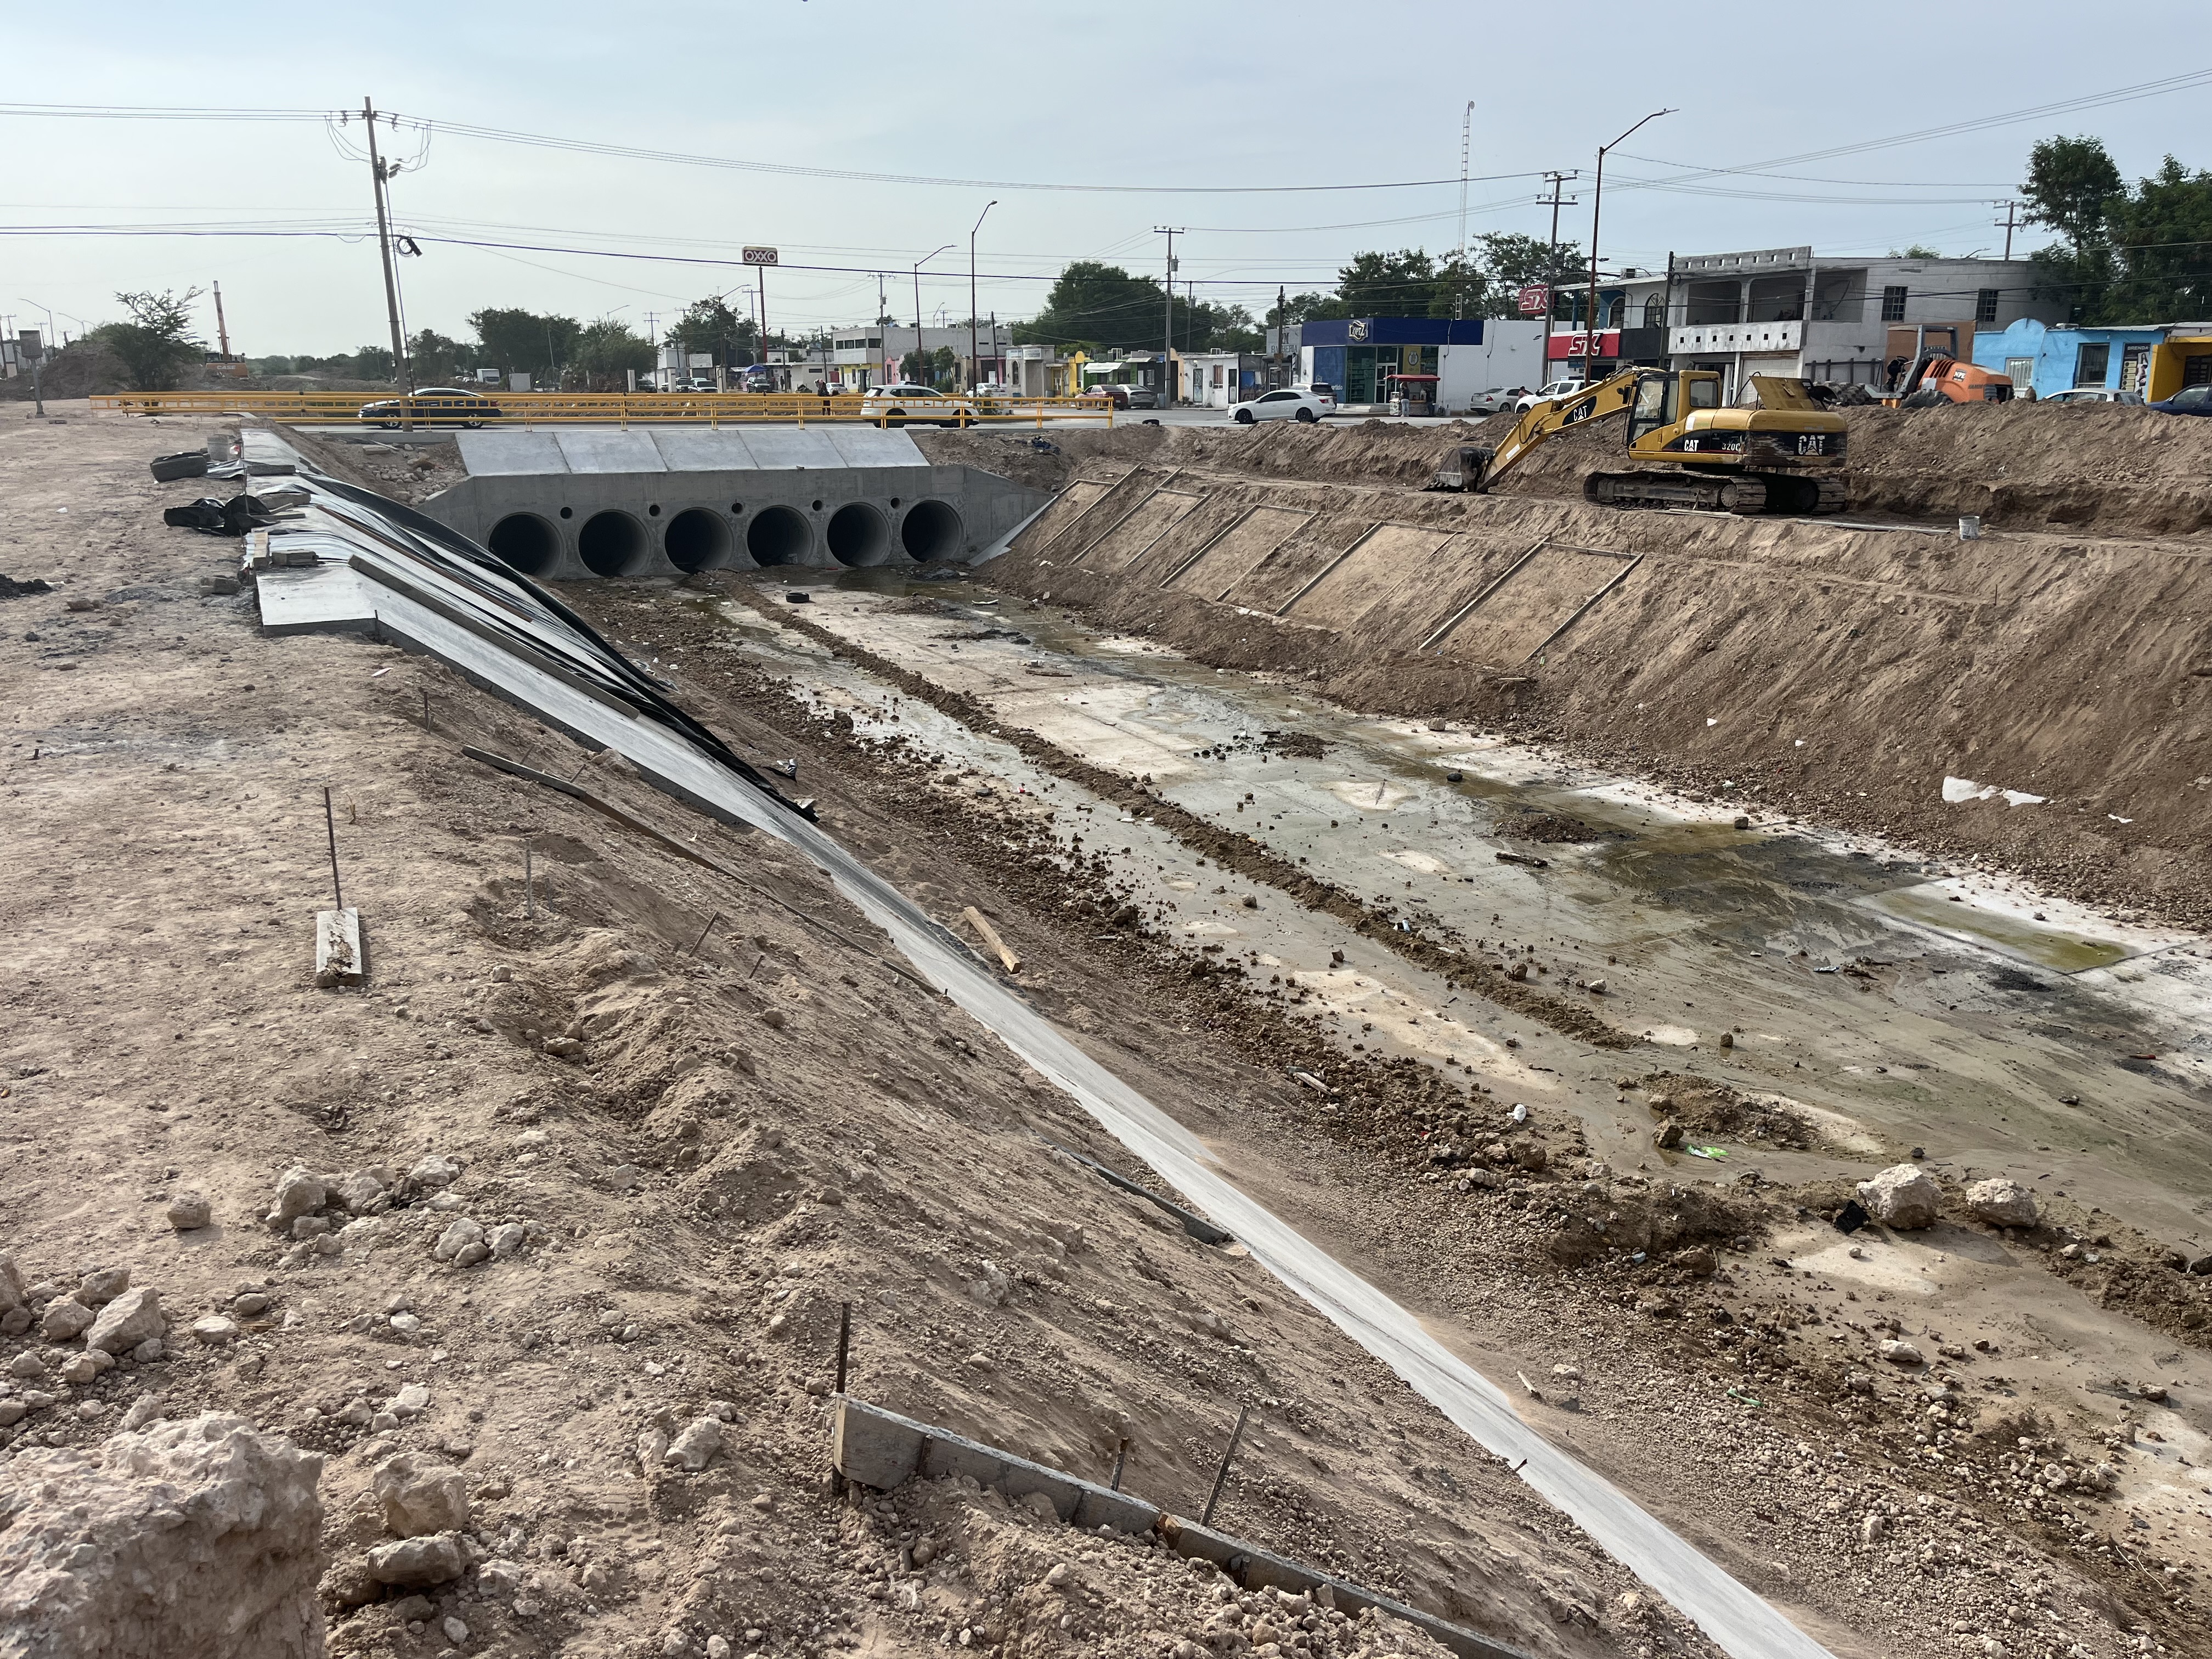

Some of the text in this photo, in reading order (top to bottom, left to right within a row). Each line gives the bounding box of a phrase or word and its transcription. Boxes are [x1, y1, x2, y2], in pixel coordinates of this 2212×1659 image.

[745, 250, 777, 262] OXXO
[1271, 345, 1297, 353] BABERIA
[1573, 405, 1587, 421] CAT
[1684, 439, 1699, 452] CAT
[1798, 435, 1825, 456] CAT
